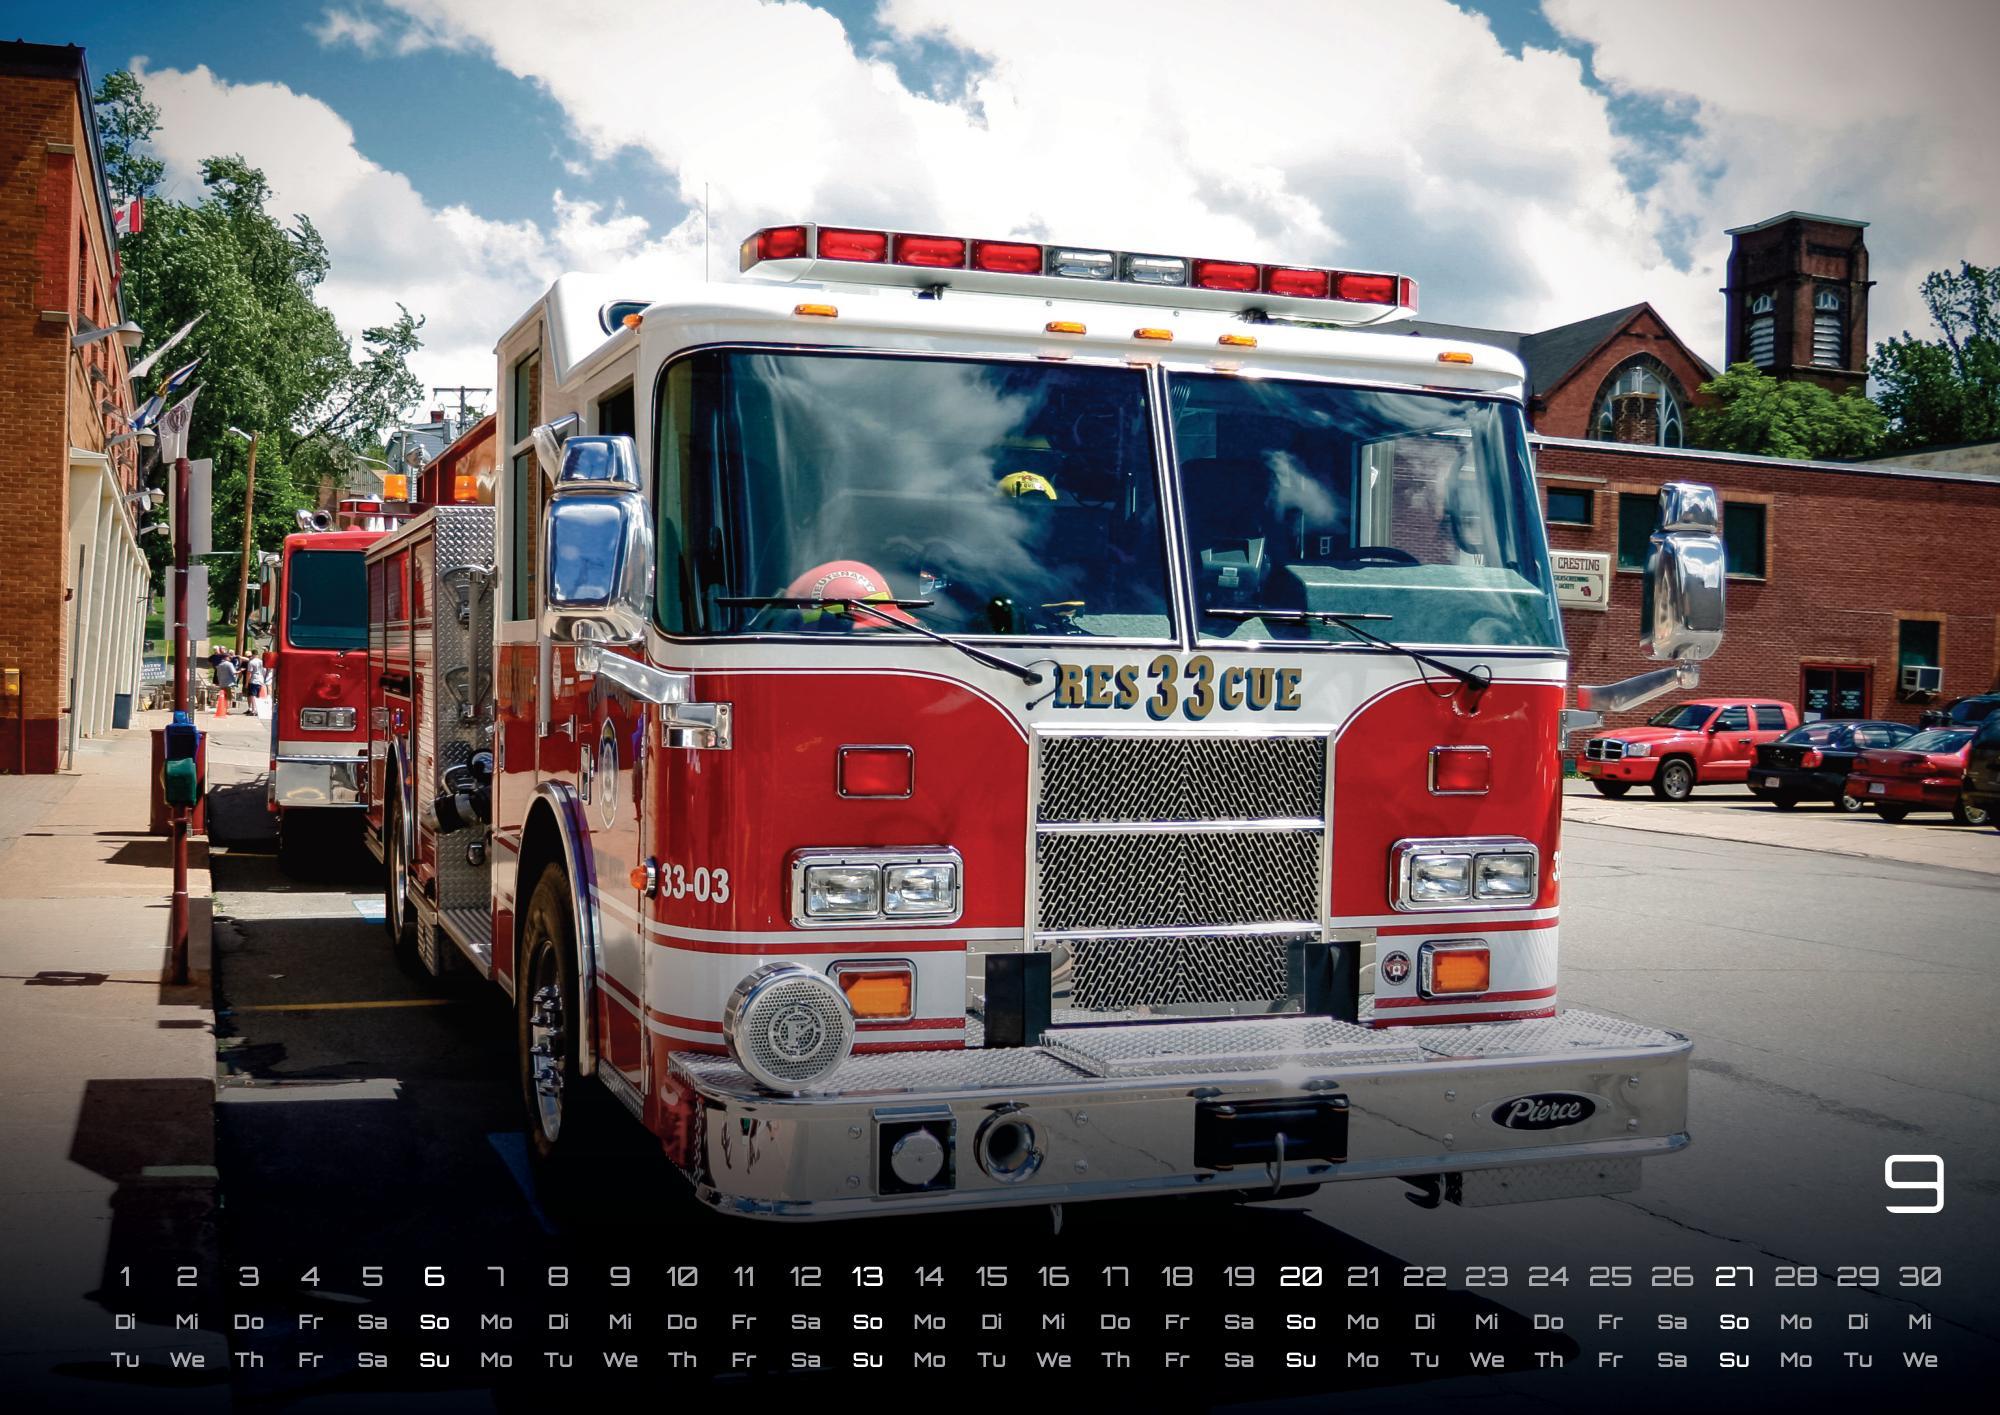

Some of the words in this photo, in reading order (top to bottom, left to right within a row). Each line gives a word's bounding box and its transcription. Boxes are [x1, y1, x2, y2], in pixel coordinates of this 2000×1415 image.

[1558, 556, 1600, 571] CRESTING
[661, 862, 730, 904] 33-03
[1505, 1098, 1582, 1127] Pierce
